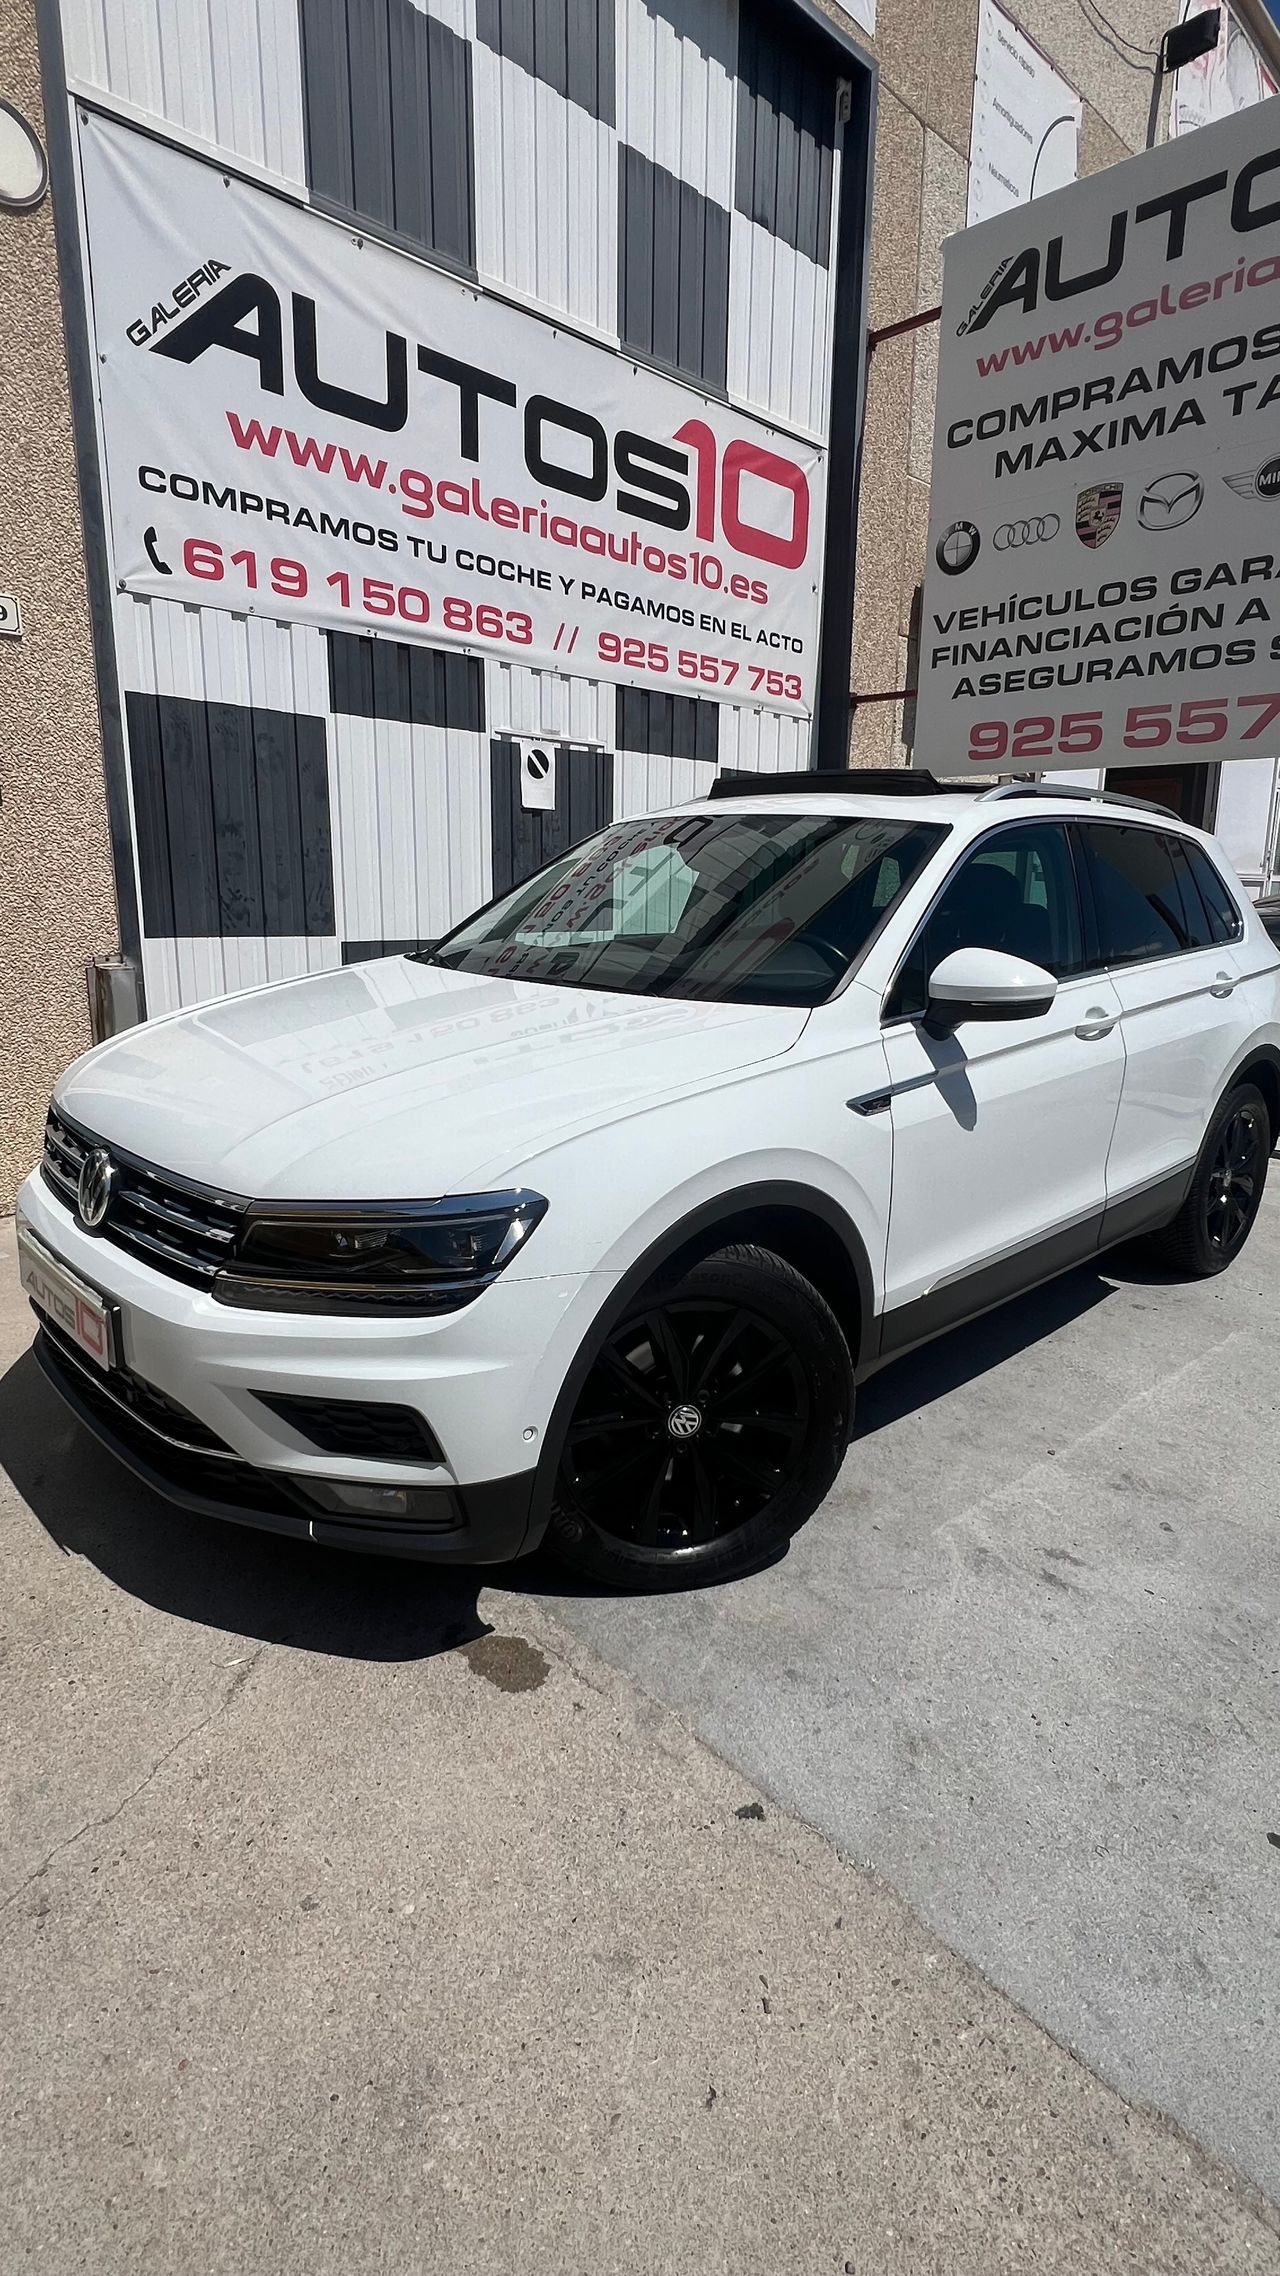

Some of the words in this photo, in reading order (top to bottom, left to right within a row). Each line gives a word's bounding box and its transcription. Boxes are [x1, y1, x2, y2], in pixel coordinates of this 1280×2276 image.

[126, 259, 232, 346] GALERIA
[956, 256, 1014, 337] GALERIA
[976, 256, 1280, 378] www.galeria
[947, 323, 1280, 449] COMPRAMOS
[995, 398, 1206, 478] MAXIMA
[226, 411, 769, 605] www.galeriaautos10.es
[138, 465, 399, 552] COMPRAMOS
[407, 536, 447, 564] TU
[456, 550, 552, 590] COCHE
[559, 576, 576, 596] Y
[581, 582, 695, 627] PAGAMOS
[700, 614, 726, 635] EN
[731, 622, 752, 642] EL
[755, 629, 803, 654] ACTO
[933, 576, 1157, 635] VEHÍCULOS
[1170, 554, 1280, 596] GAR
[183, 538, 309, 599] 619
[327, 571, 431, 624] 150
[443, 596, 534, 645] 863
[597, 631, 670, 673] 925
[677, 650, 740, 685] 557
[748, 666, 802, 701] 753
[931, 602, 1226, 670] FINANCIACIÓN
[1235, 597, 1271, 627] A
[951, 639, 1257, 700] ASEGURAMOS
[967, 710, 1104, 761] 925
[1122, 691, 1280, 749] 557
